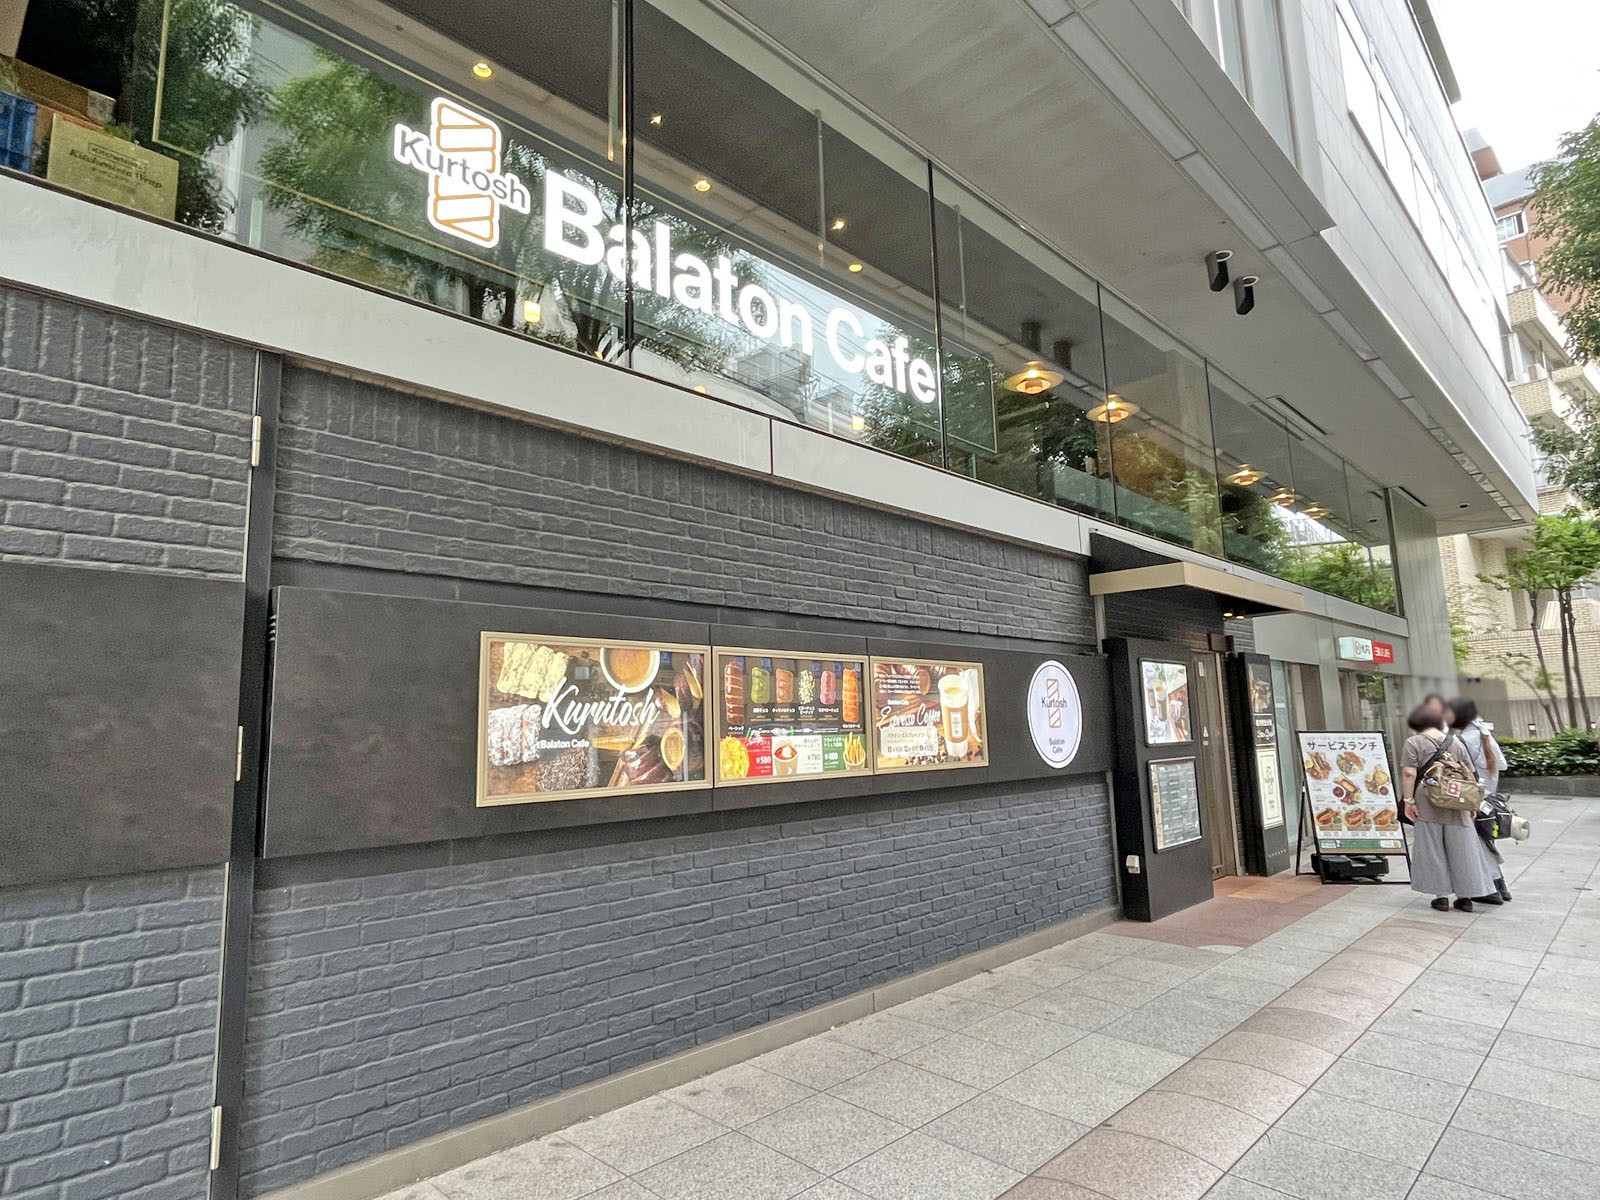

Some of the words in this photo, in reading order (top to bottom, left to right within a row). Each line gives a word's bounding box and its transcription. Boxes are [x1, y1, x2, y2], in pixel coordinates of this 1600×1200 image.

[398, 127, 529, 212] Kurtosh
[544, 168, 811, 357] Balaton
[826, 306, 936, 404] Cafe
[1041, 697, 1067, 708] Kurtosh
[1307, 741, 1377, 751] サービスランチ
